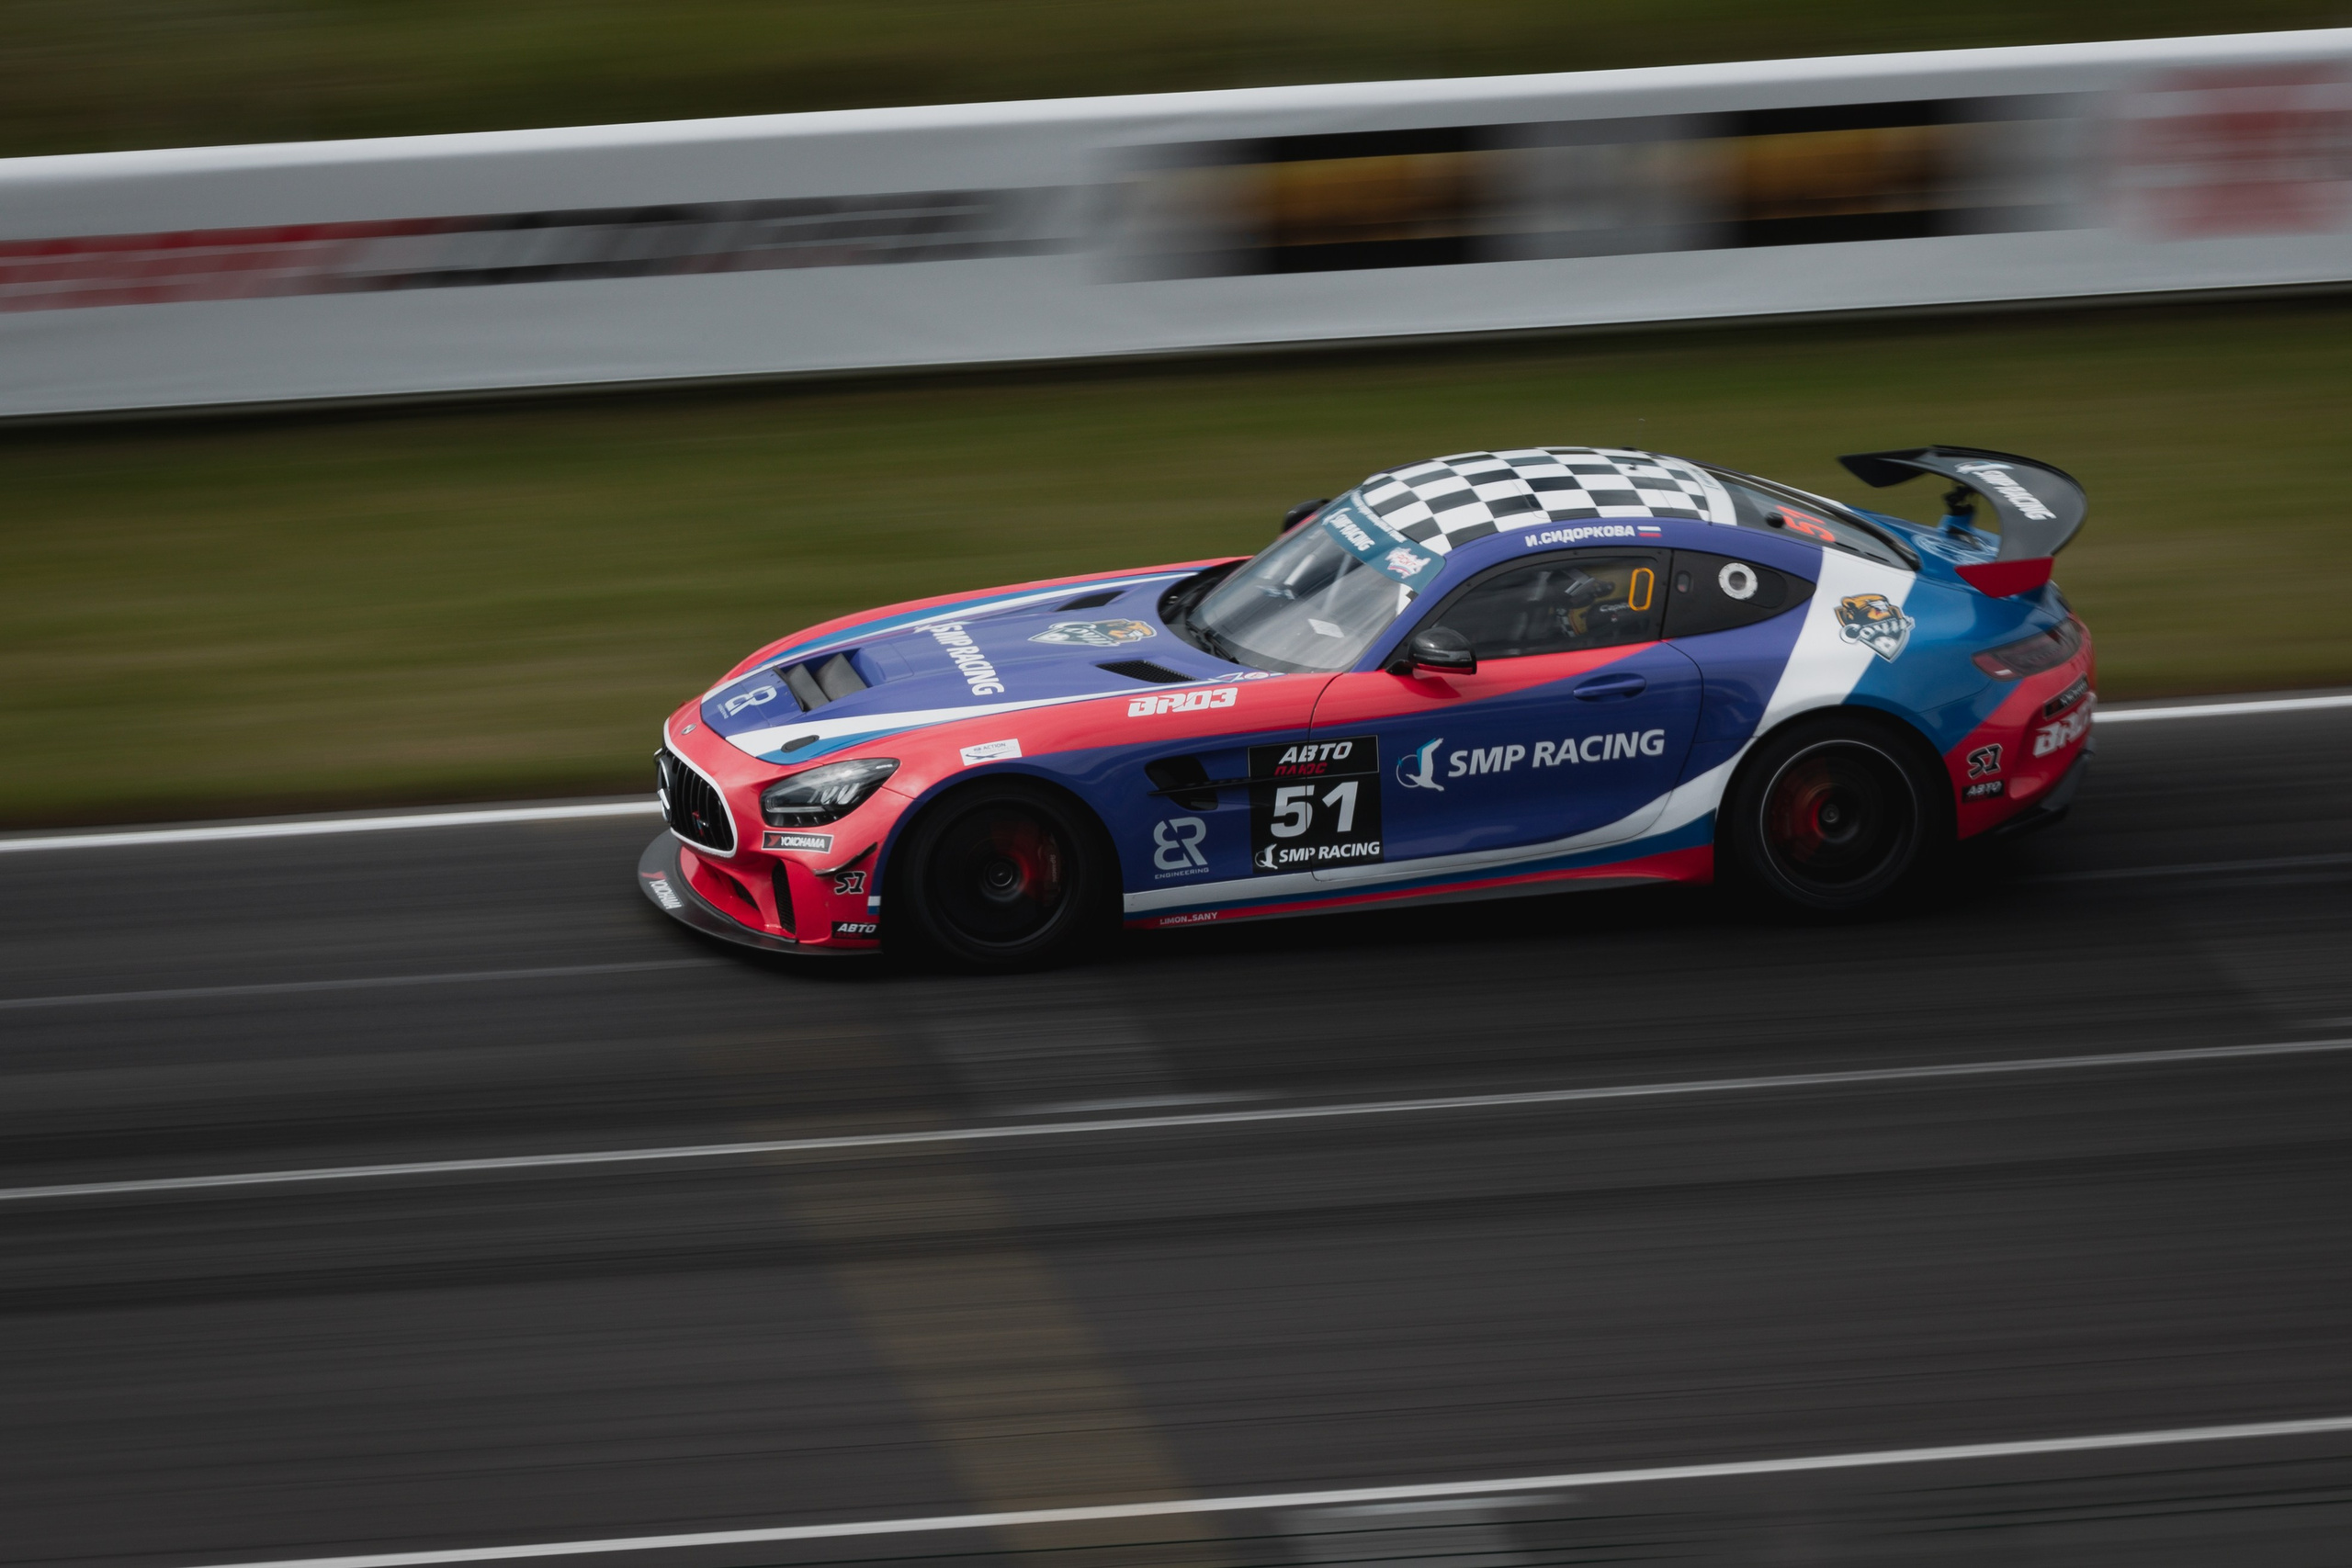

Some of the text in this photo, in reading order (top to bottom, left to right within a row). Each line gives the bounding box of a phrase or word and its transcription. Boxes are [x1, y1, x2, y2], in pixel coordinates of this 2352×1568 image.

[1994, 486, 2057, 520] RACING
[1775, 504, 1836, 542] 51
[1340, 524, 1375, 551] RACING
[1524, 525, 1635, 547] И.СИДОРКОВА
[930, 625, 973, 646] SMP
[946, 646, 1004, 695] RACING
[1448, 729, 1665, 777] SMP RACING
[1271, 781, 1358, 838] 51
[781, 836, 825, 848] YOKOHAMA
[1279, 841, 1380, 863] SMP RACING
[1154, 867, 1210, 879] ENGINEERING
[1159, 912, 1217, 925] LIMON_SANY
